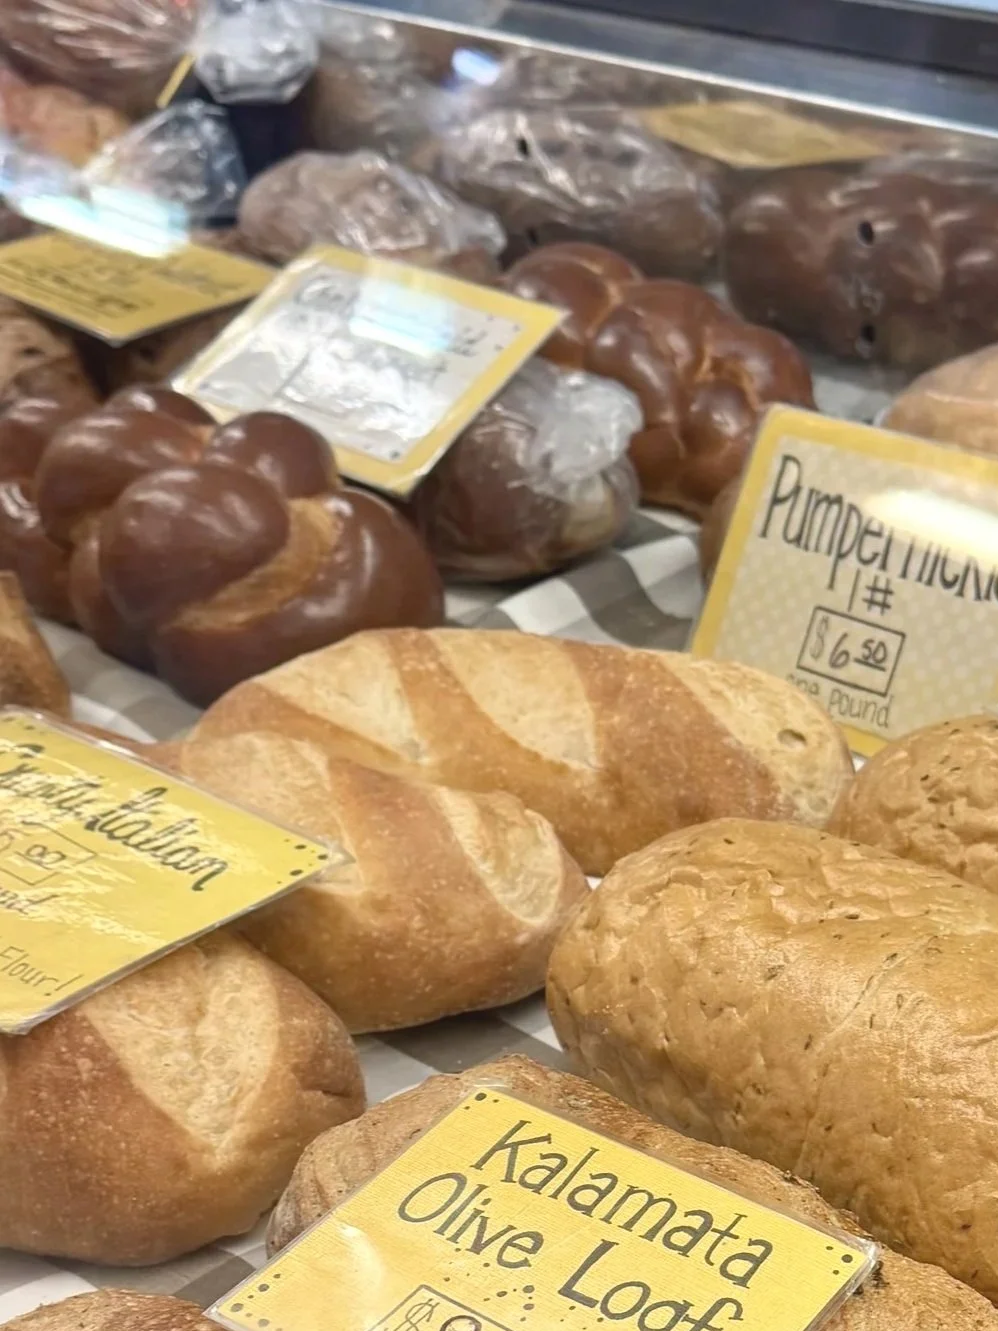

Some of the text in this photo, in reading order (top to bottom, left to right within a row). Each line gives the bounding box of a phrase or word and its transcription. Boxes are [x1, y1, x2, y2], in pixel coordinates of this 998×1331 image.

[83, 786, 228, 891] Italian
[396, 1171, 545, 1270] Olive
[470, 1119, 775, 1289] Kalamata
